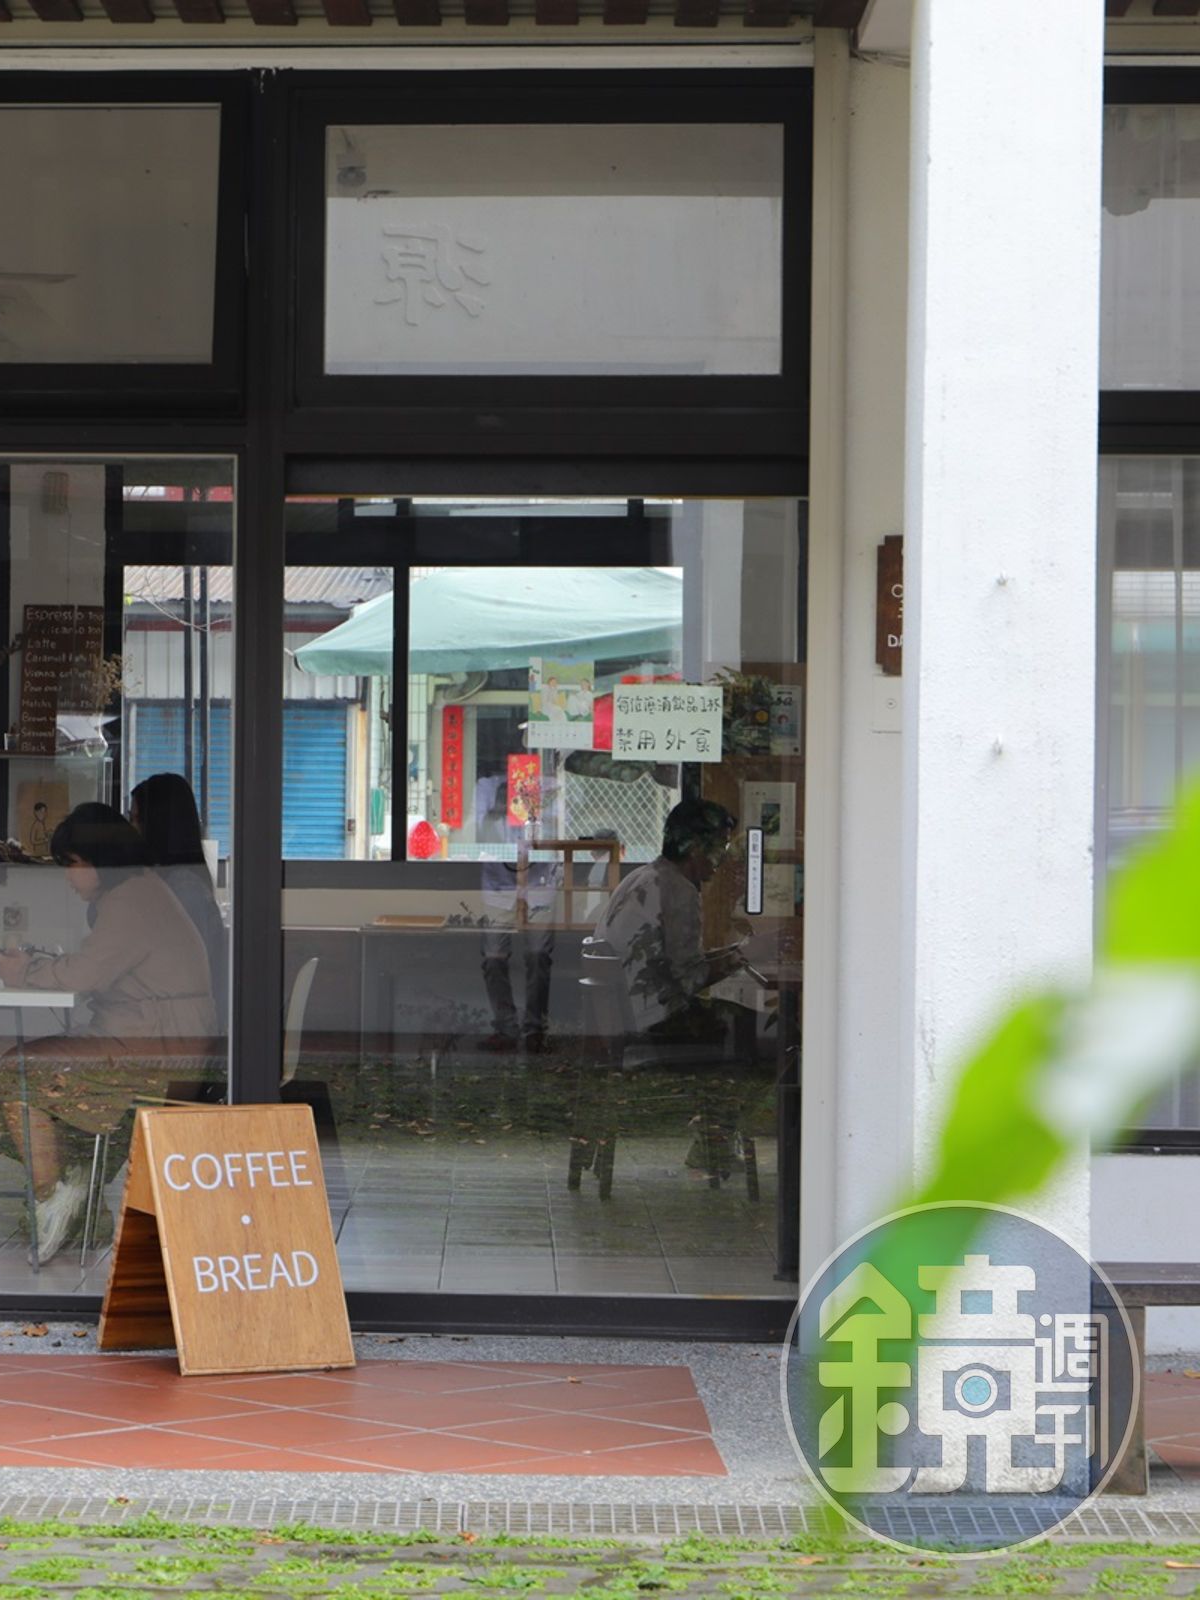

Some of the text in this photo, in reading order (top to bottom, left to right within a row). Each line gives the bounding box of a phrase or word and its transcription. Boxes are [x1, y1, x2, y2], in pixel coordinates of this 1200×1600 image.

[26, 607, 85, 623] Espresso
[27, 624, 85, 635] icano
[27, 638, 57, 649] Latte
[25, 652, 66, 663] Caramel
[24, 668, 57, 678] Vienna
[616, 728, 711, 753] 禁用外食
[163, 1150, 313, 1191] COFFEE
[192, 1250, 320, 1294] BREAD
